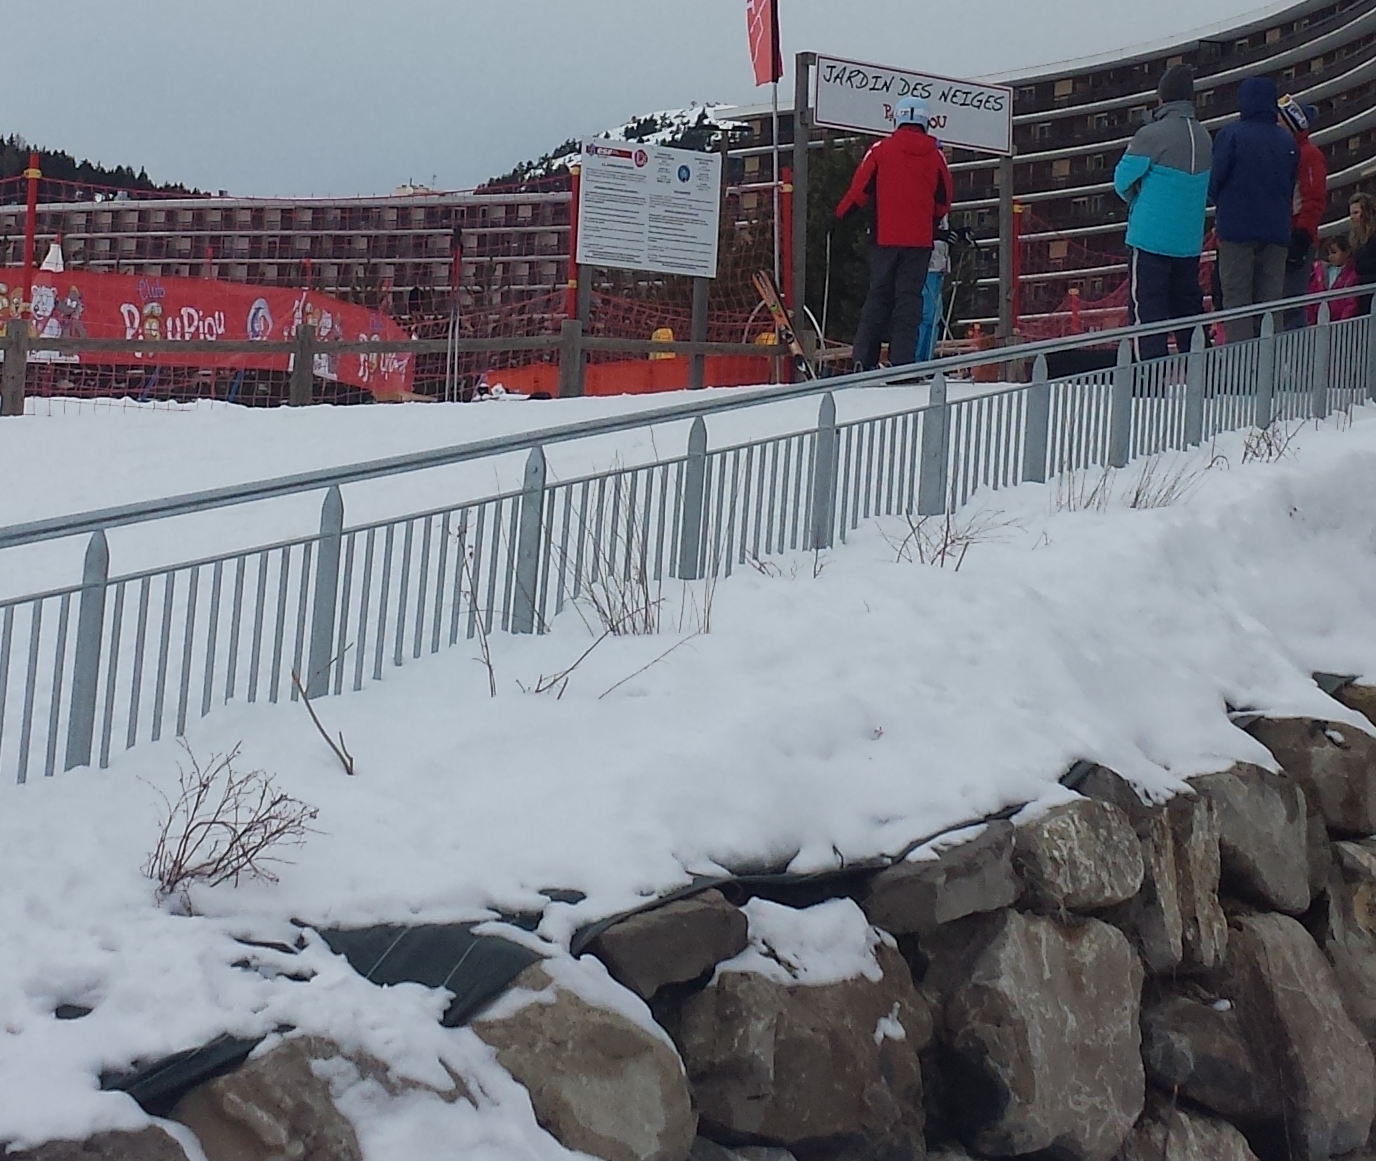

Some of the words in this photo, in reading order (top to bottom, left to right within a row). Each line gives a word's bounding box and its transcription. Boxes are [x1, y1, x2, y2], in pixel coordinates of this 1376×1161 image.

[823, 64, 895, 93] JARDIN
[897, 77, 933, 99] DES
[938, 86, 1005, 112] NEIGES
